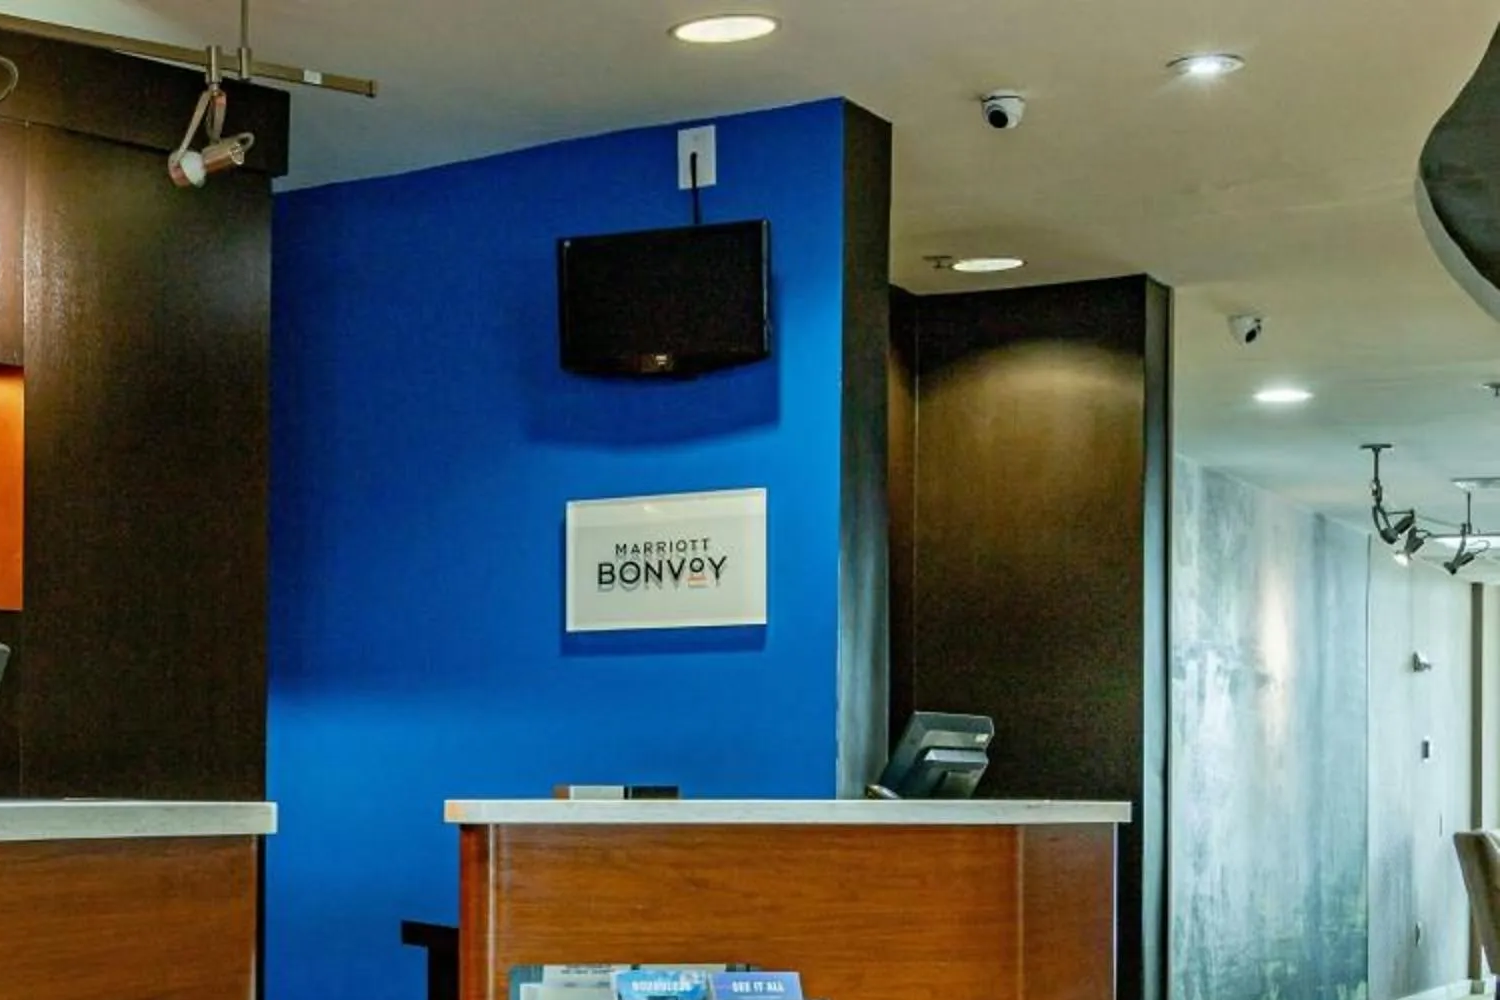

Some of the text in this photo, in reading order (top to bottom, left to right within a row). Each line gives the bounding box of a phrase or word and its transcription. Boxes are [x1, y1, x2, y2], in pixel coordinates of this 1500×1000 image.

[615, 538, 711, 556] MARRIOTT
[597, 555, 728, 585] BONVOY
[732, 980, 785, 993] SEE IT ALL
